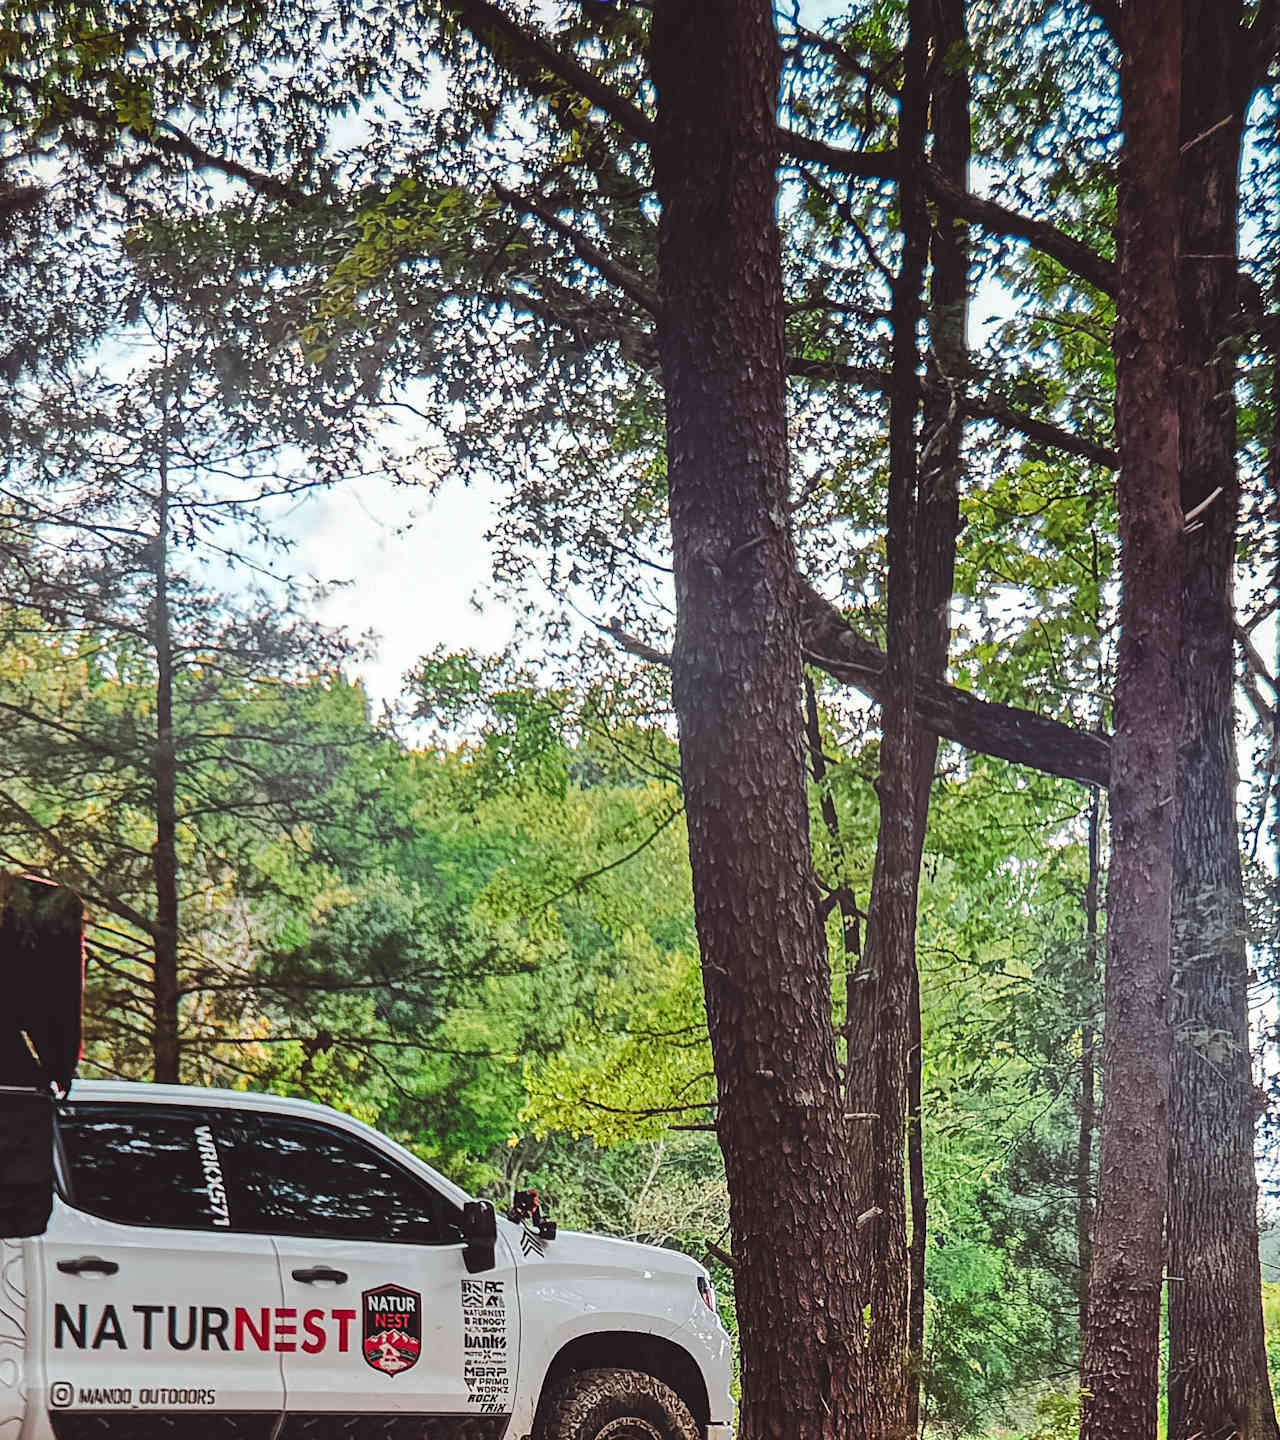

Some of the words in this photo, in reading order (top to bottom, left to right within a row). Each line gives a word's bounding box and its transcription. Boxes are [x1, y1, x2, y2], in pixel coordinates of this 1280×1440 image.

[368, 1295, 415, 1312] NATUR
[375, 1313, 410, 1328] NEST
[54, 1303, 356, 1354] NATURNEST
[464, 1367, 507, 1377] MBRP
[479, 1378, 509, 1386] PRIMO
[477, 1386, 509, 1394] WORKZ
[467, 1394, 498, 1403] ROCK
